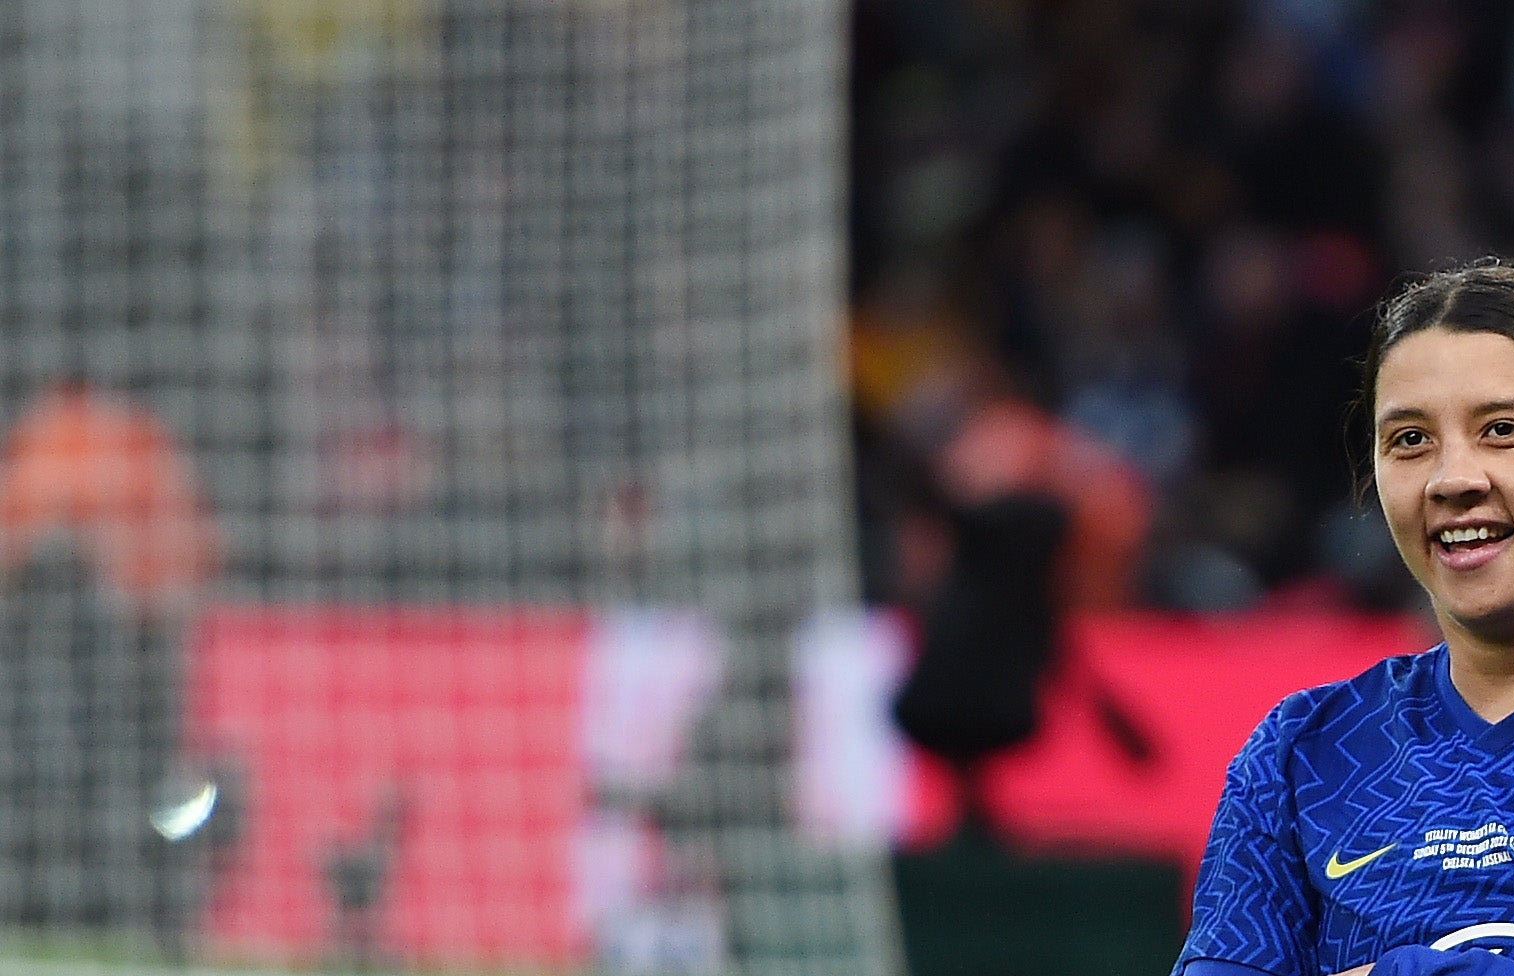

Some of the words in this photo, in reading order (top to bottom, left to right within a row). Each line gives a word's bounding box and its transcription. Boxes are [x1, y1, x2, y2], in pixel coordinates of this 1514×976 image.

[1425, 829, 1458, 842] VITALITY
[1413, 844, 1439, 860] SUNDAY
[1442, 857, 1474, 870] CHELSEA
[1482, 851, 1512, 867] ARSENAL
